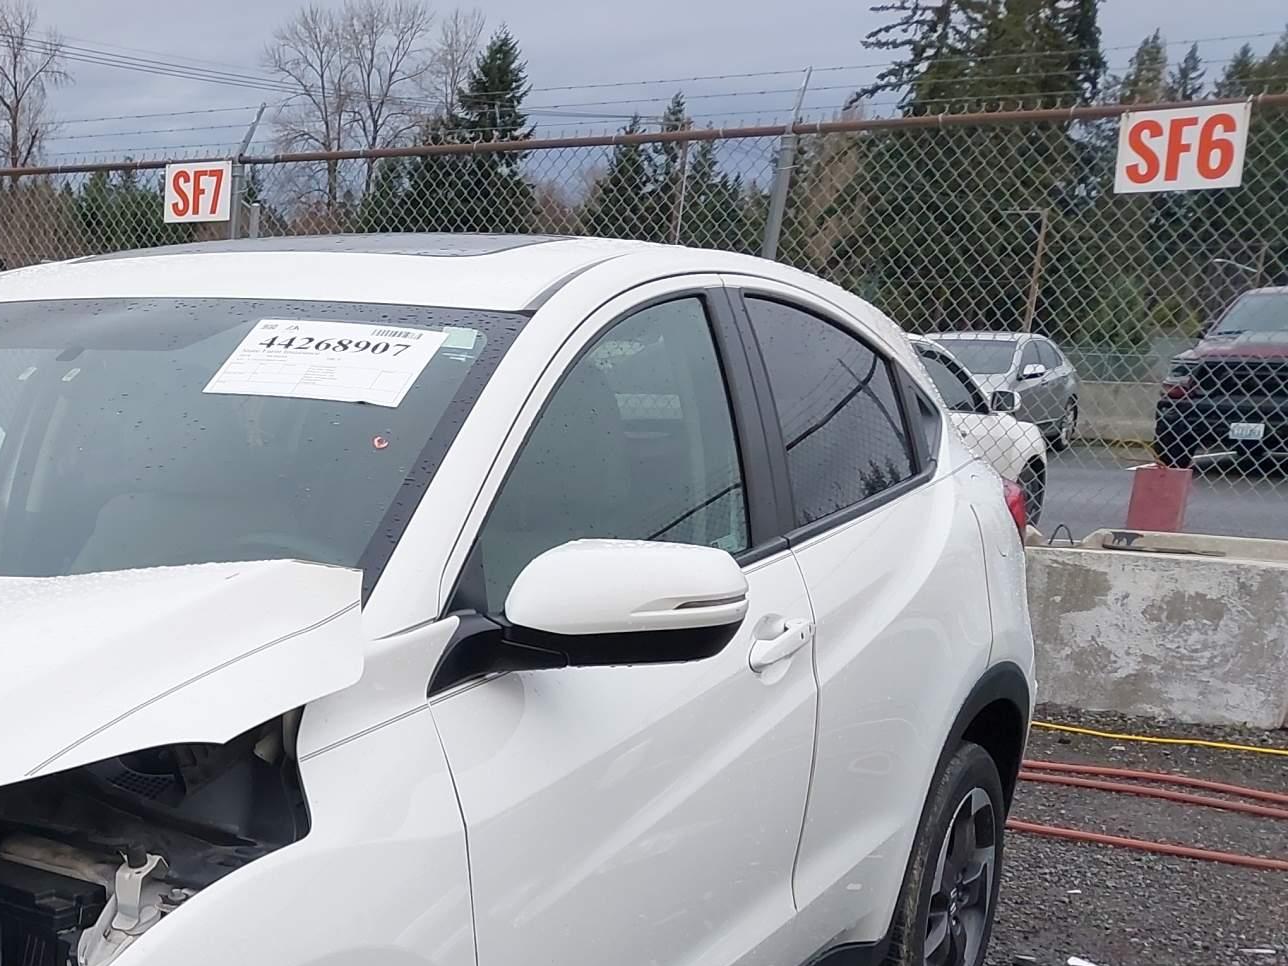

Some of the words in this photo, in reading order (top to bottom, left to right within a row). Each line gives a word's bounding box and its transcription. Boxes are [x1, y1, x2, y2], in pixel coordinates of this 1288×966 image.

[1125, 112, 1237, 184] SF6
[171, 168, 224, 217] SF7
[259, 336, 412, 357] 44268907
